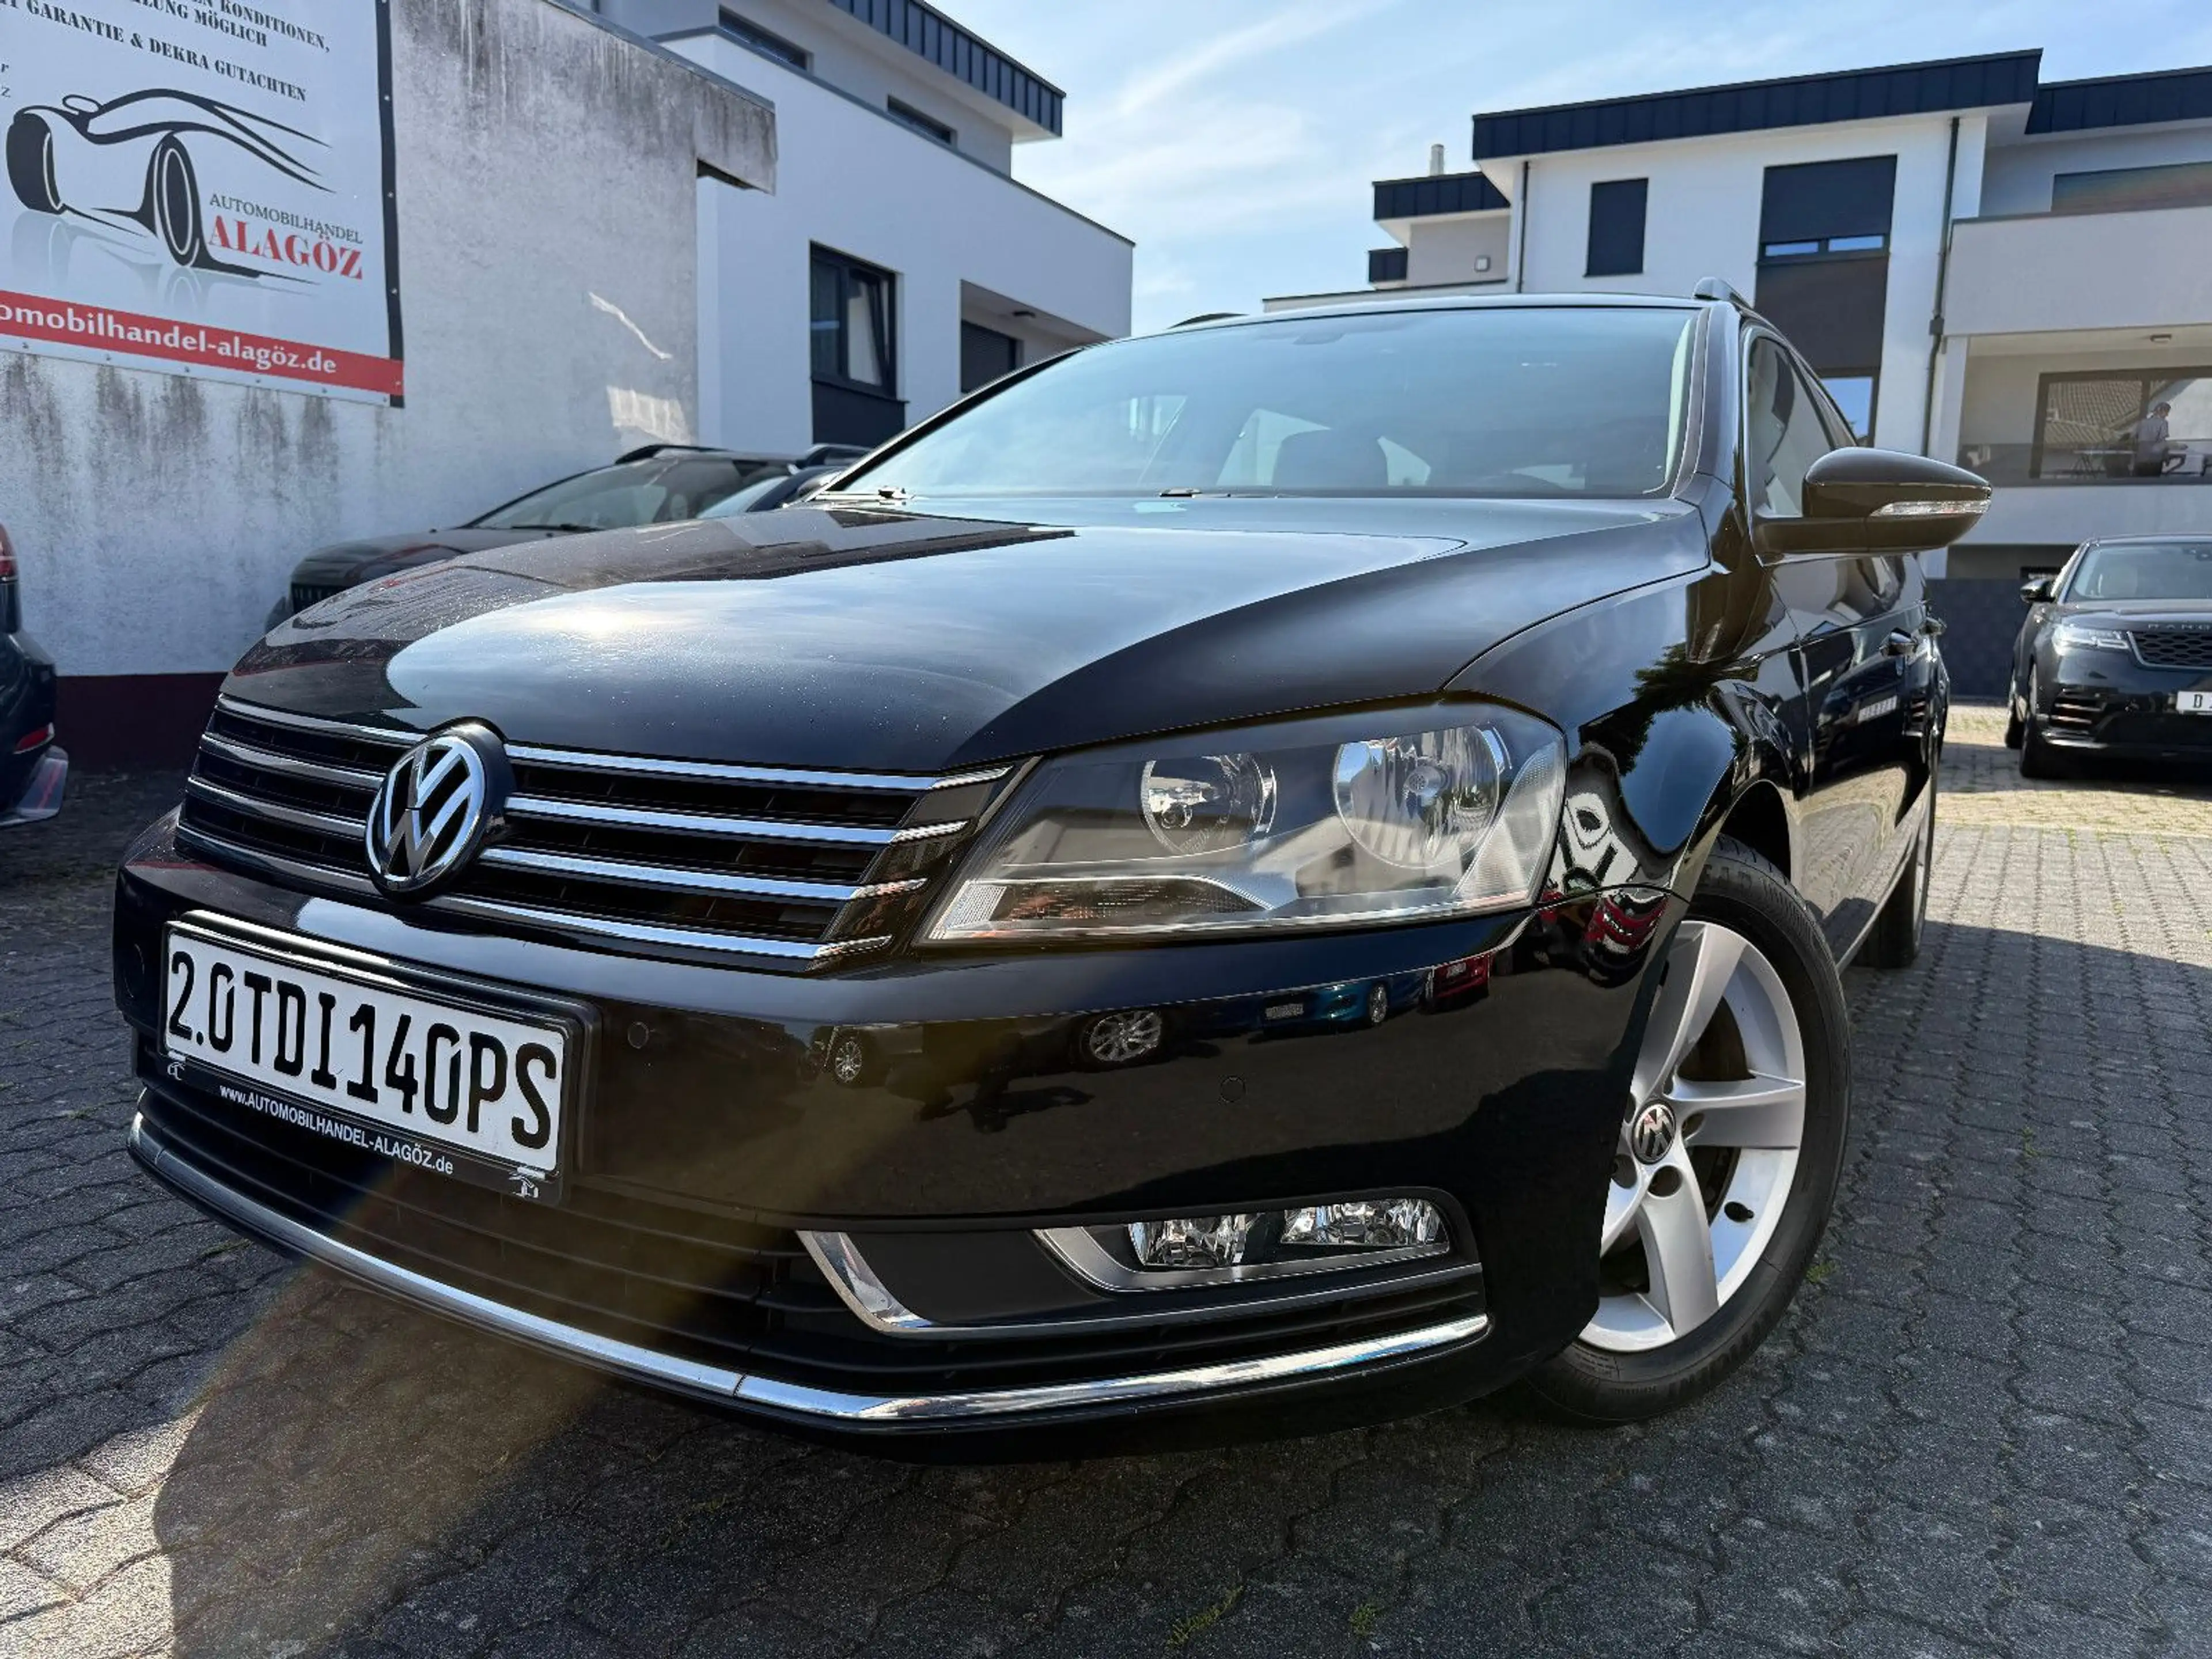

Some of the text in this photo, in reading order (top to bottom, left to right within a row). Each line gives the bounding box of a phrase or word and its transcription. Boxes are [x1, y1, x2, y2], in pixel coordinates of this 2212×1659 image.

[26, 0, 306, 101] GARANTIE & DEKRA GUTACHTEN
[194, 9, 267, 47] MÖGLICH
[220, 0, 330, 52] KONDITIONEN,
[207, 215, 363, 280] ALAGÖZ
[210, 194, 363, 244] AUTOMOBILHANDEL
[0, 304, 336, 373] omobilhandel-alagöz.de
[169, 951, 557, 1150] 2.0TDI140PS
[220, 1085, 454, 1175] www.AUTOMOBILHANDEL-ALAGÖZ.de
